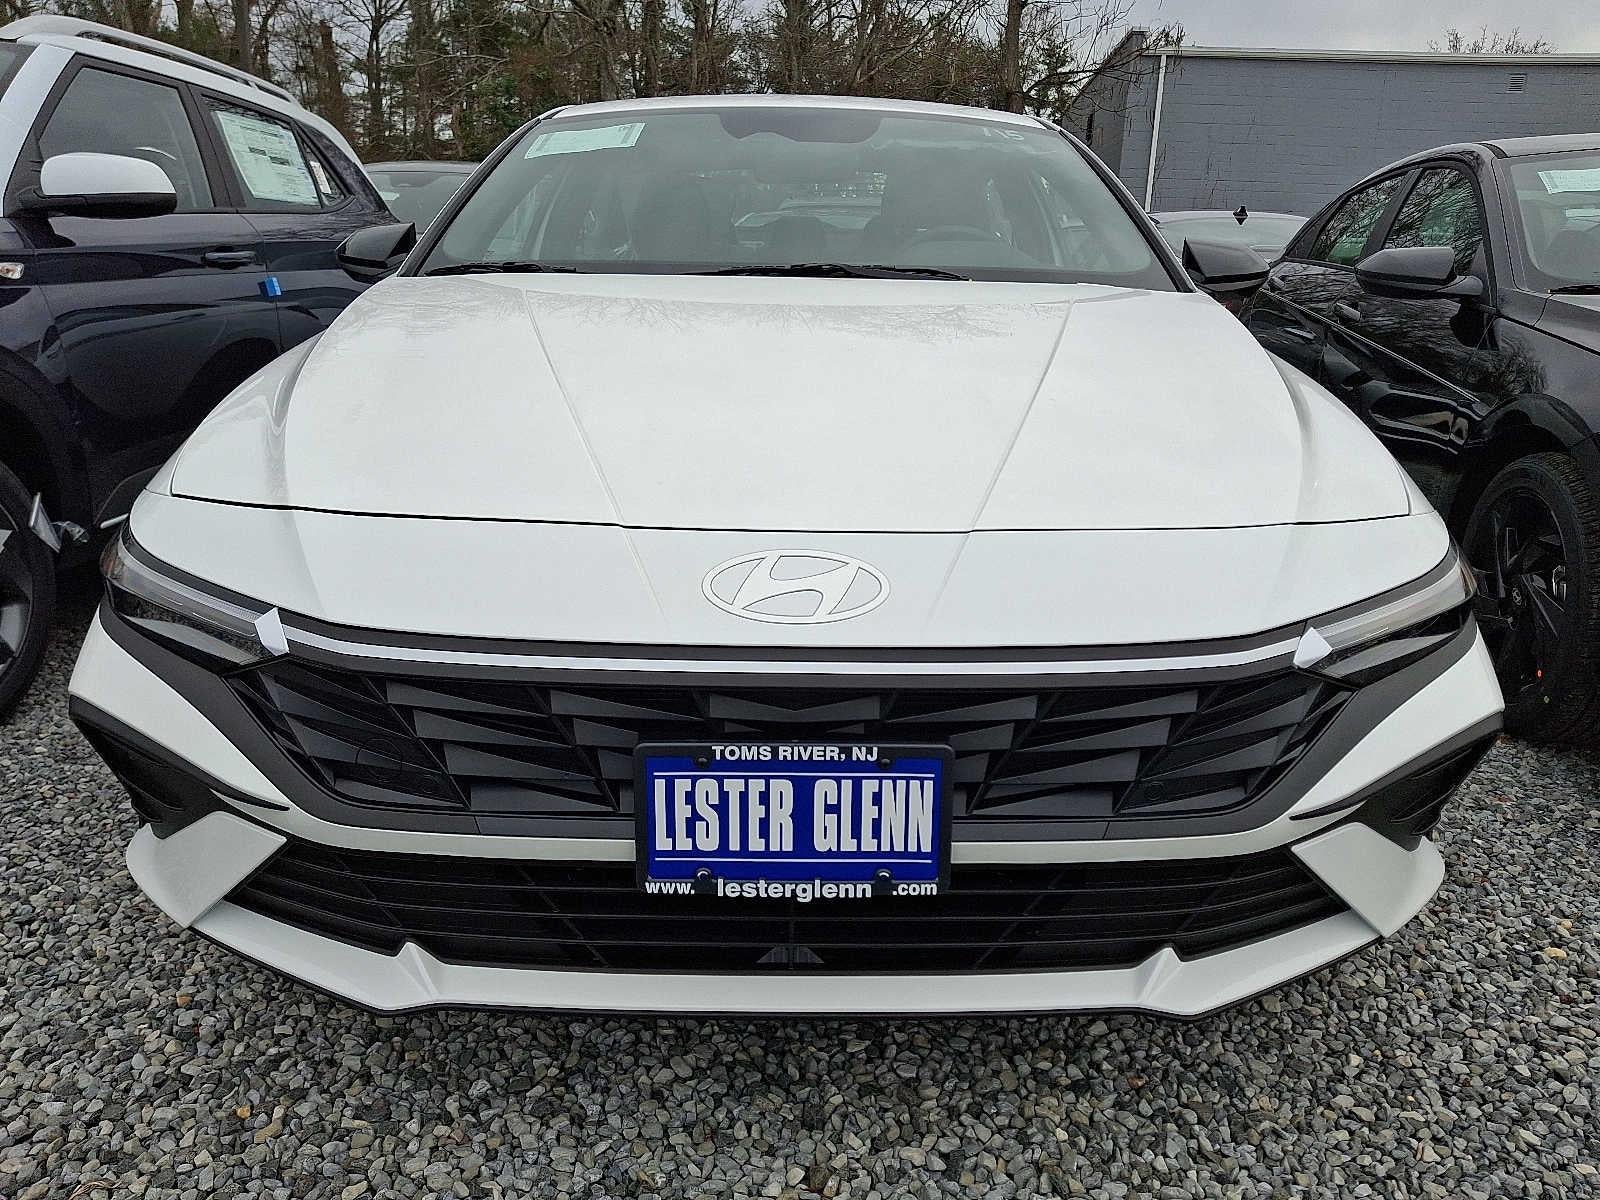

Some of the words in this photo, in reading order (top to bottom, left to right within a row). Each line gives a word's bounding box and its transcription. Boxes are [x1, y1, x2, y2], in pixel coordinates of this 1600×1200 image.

[711, 745, 772, 761] TOMS
[778, 745, 846, 762] RIVER,
[851, 746, 879, 761] NJ
[654, 778, 794, 851] LESTER
[813, 778, 934, 853] GLENN
[645, 882, 695, 894] www.
[717, 879, 872, 902] lesterglenn
[892, 883, 938, 896] .com
